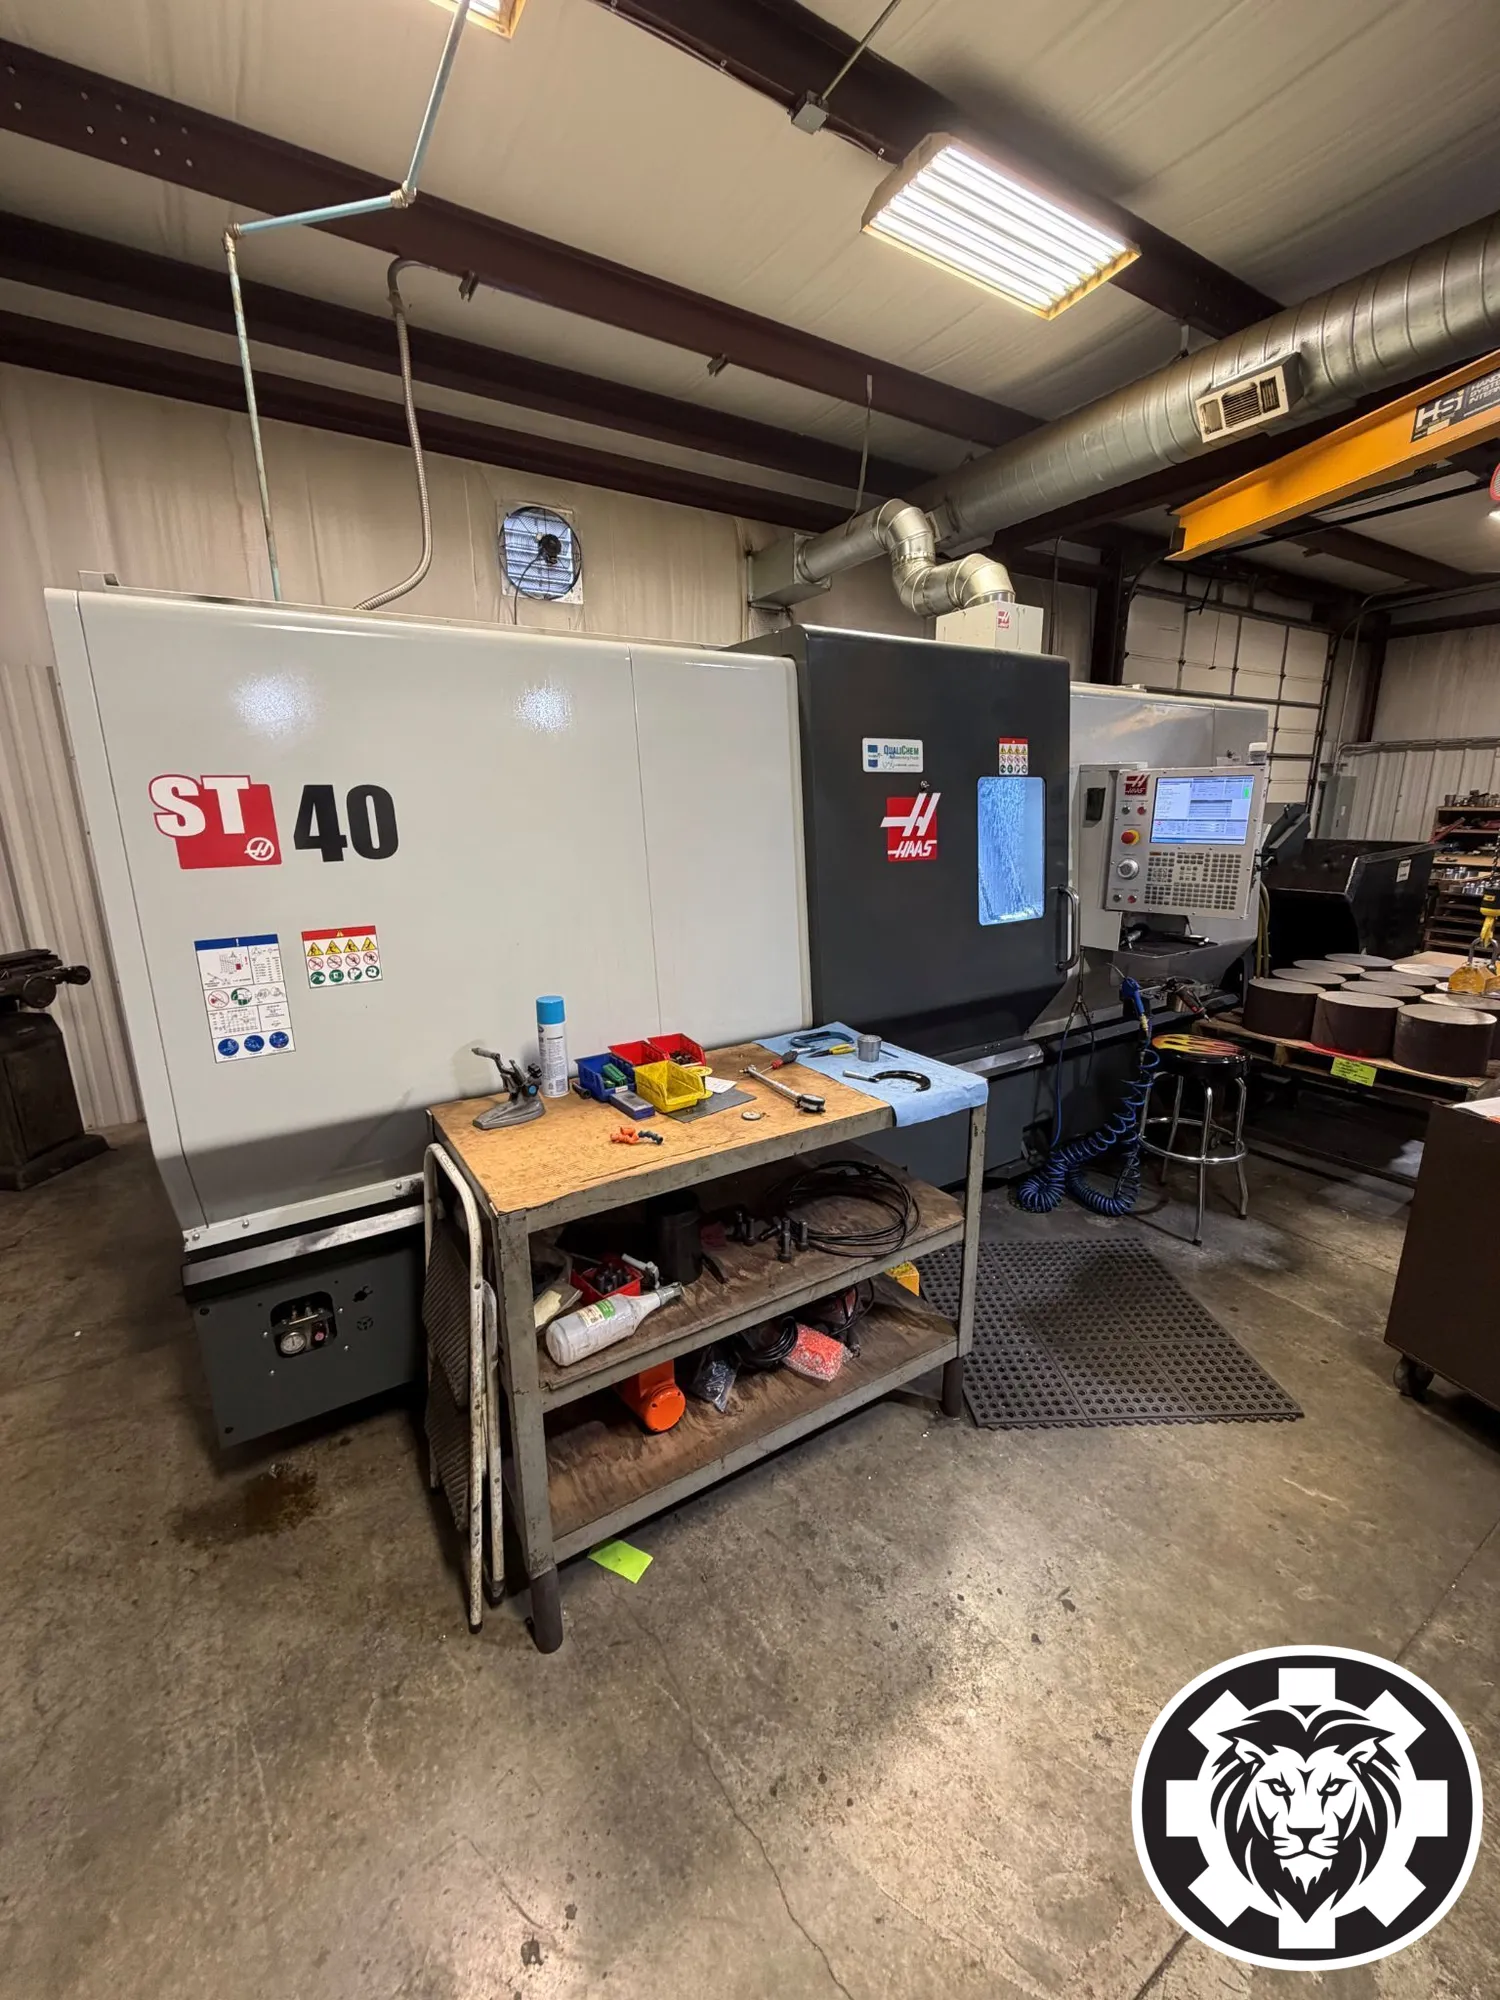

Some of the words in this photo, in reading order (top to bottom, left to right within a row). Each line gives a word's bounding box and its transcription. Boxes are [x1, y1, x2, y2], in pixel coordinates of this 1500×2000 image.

[148, 774, 250, 837] ST
[294, 784, 399, 862] 40
[887, 840, 937, 858] HAAS
